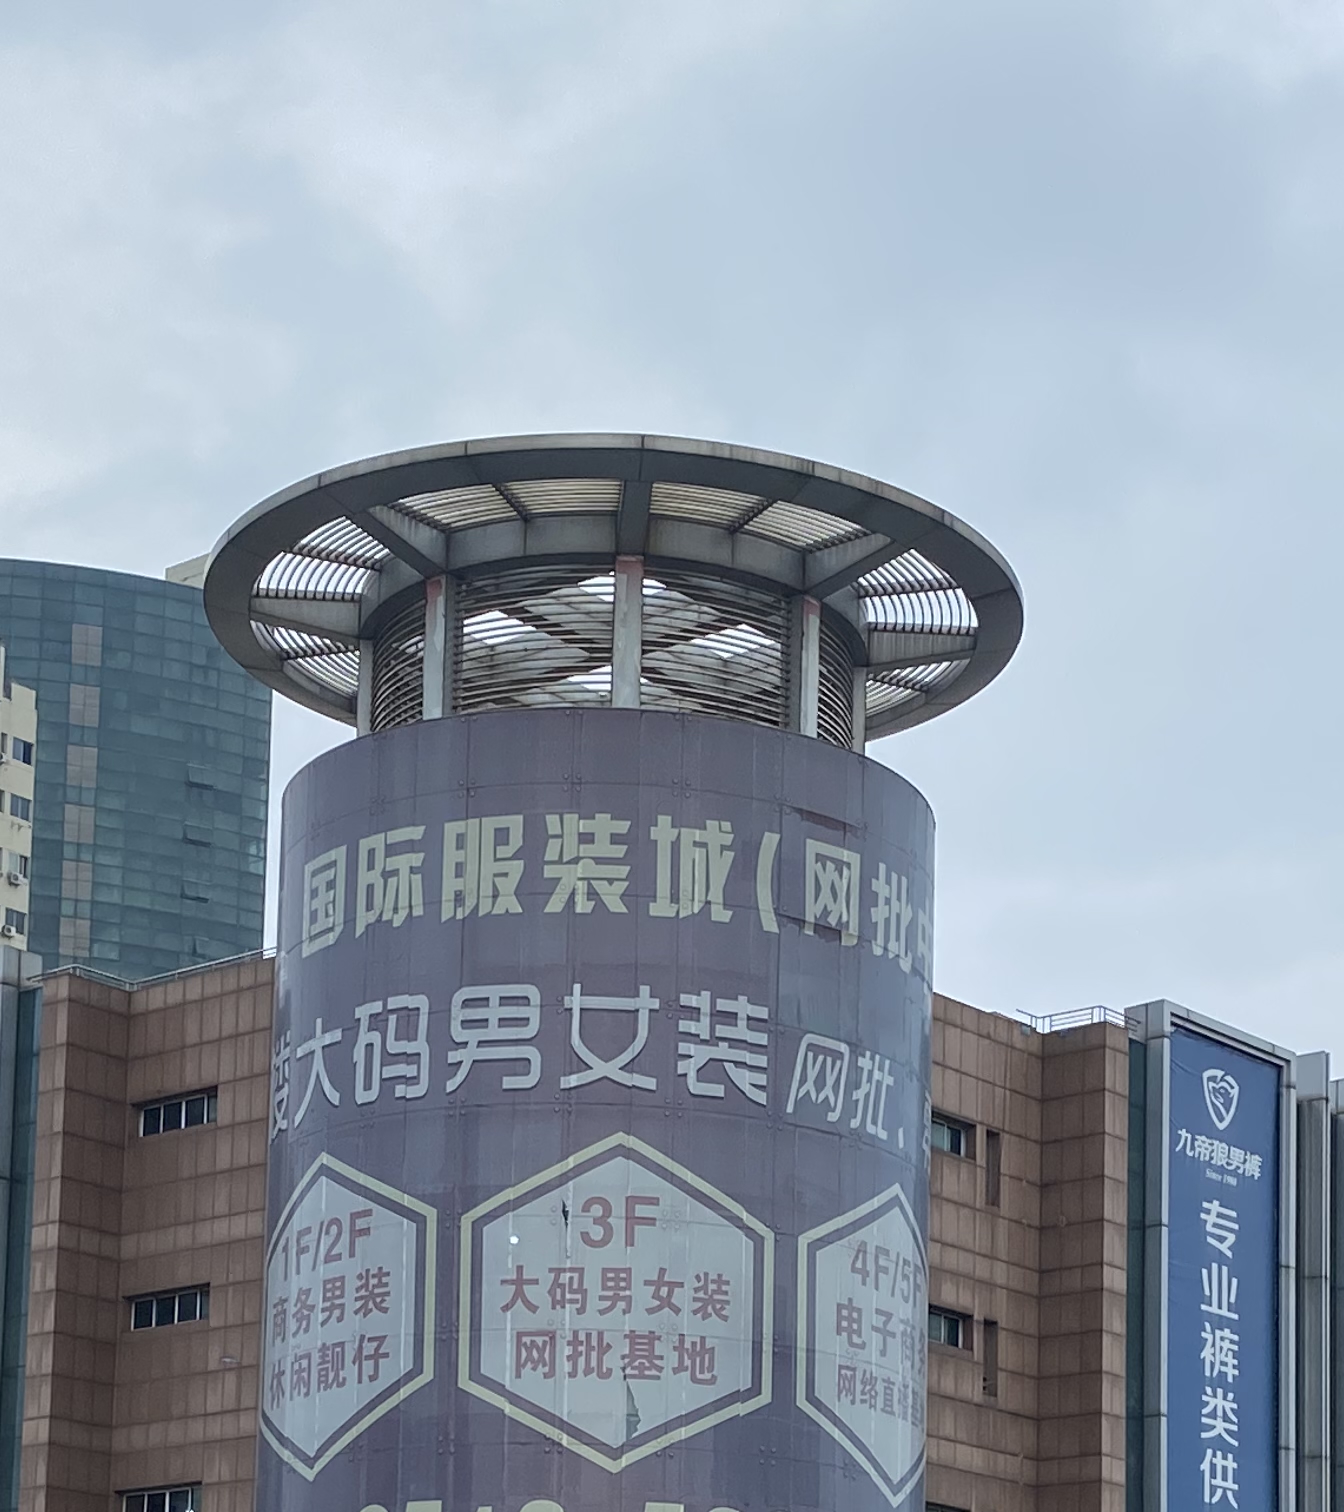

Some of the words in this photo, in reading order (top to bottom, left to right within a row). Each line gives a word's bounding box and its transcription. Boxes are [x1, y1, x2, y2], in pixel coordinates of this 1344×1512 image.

[1175, 1128, 1262, 1180] 九帝狼男裤
[579, 1196, 660, 1249] 3F
[272, 1265, 391, 1347] 商务男装
[499, 1266, 730, 1323] 大码男女装
[270, 1333, 390, 1411] 休闲靓仔
[515, 1331, 718, 1386] 网批基地
